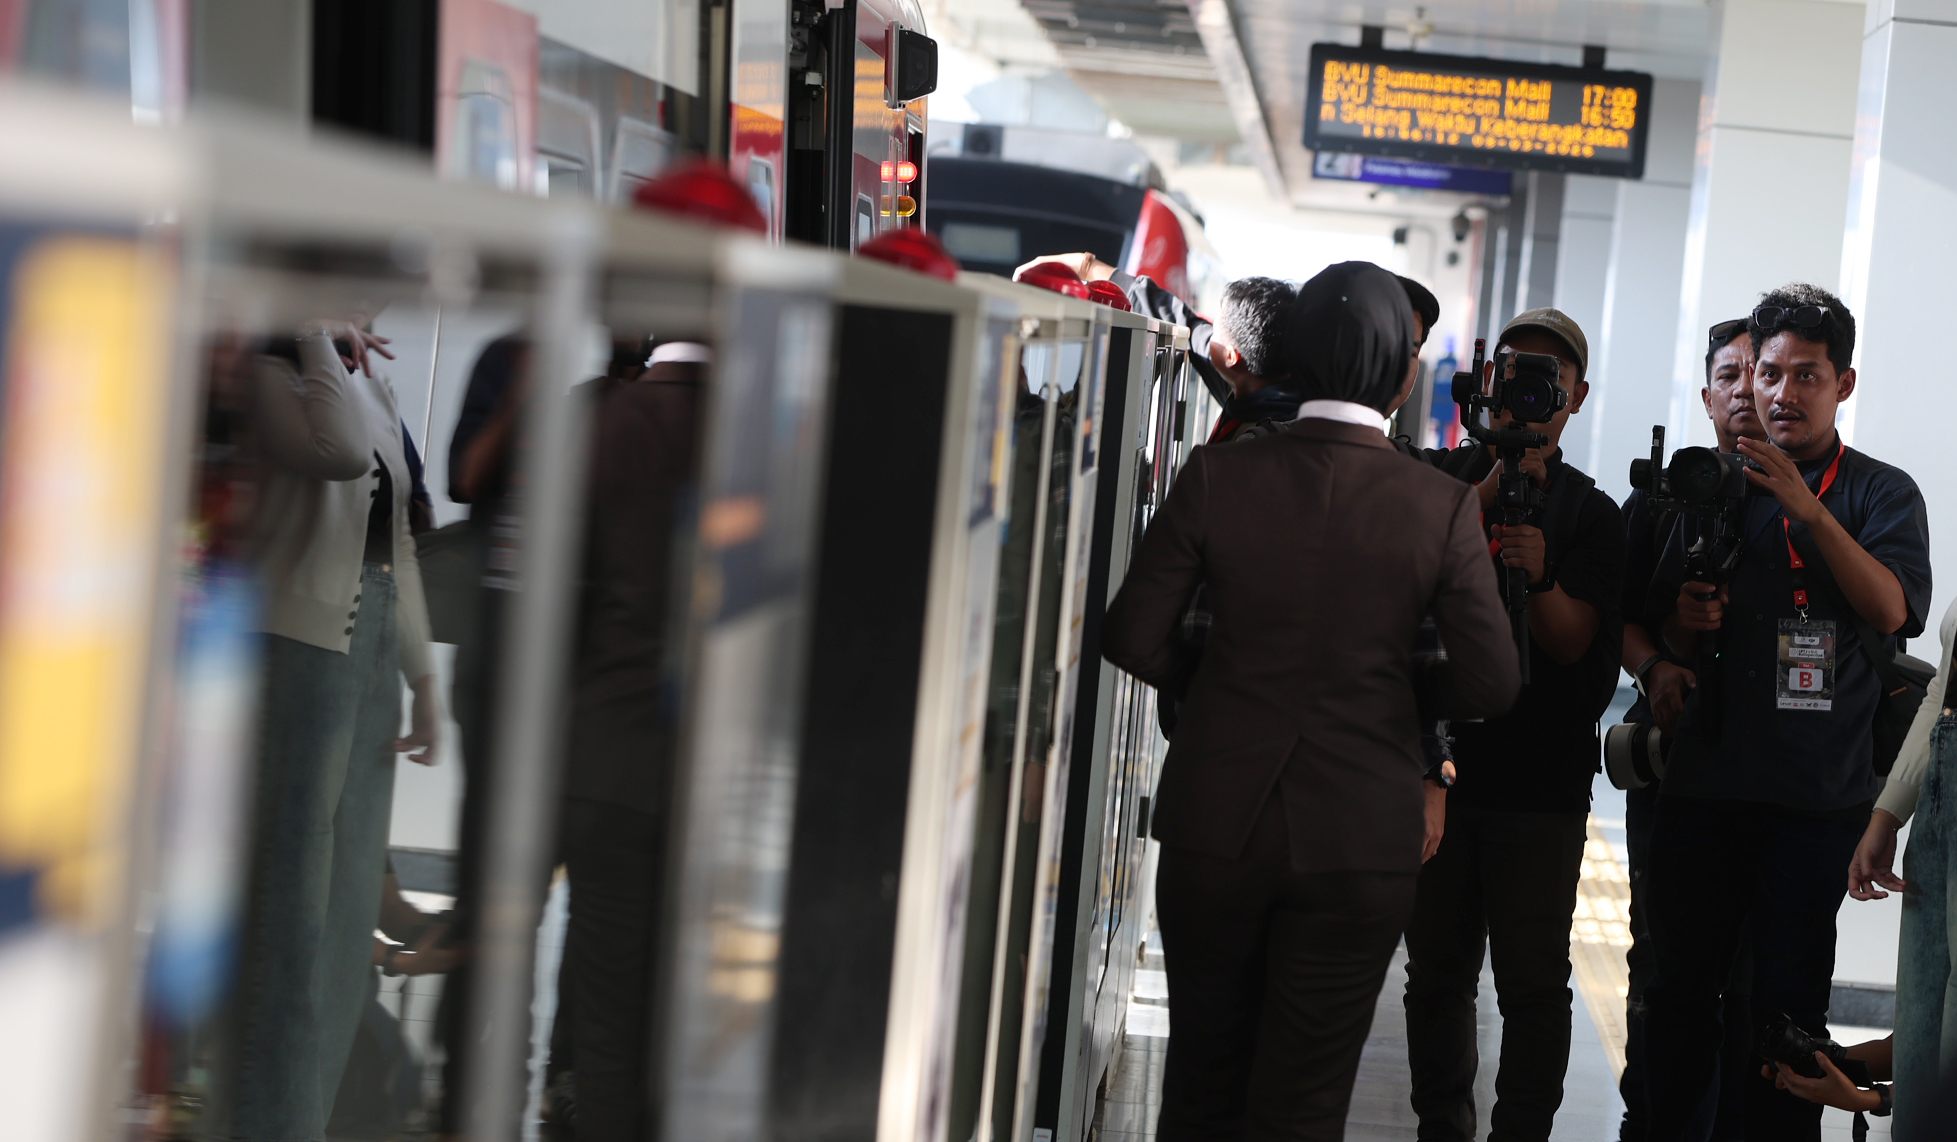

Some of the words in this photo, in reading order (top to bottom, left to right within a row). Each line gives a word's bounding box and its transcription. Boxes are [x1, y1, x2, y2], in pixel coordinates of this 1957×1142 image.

[1322, 80, 1368, 105] BVU
[1372, 84, 1500, 118] Summarecon
[1504, 98, 1550, 122] Mall
[1581, 105, 1635, 130] 16:50
[1324, 60, 1370, 84] BVU
[1373, 65, 1502, 98] Summarecon
[1506, 77, 1552, 101] Mall
[1583, 84, 1638, 108] 17:00
[1800, 672, 1812, 688] B
